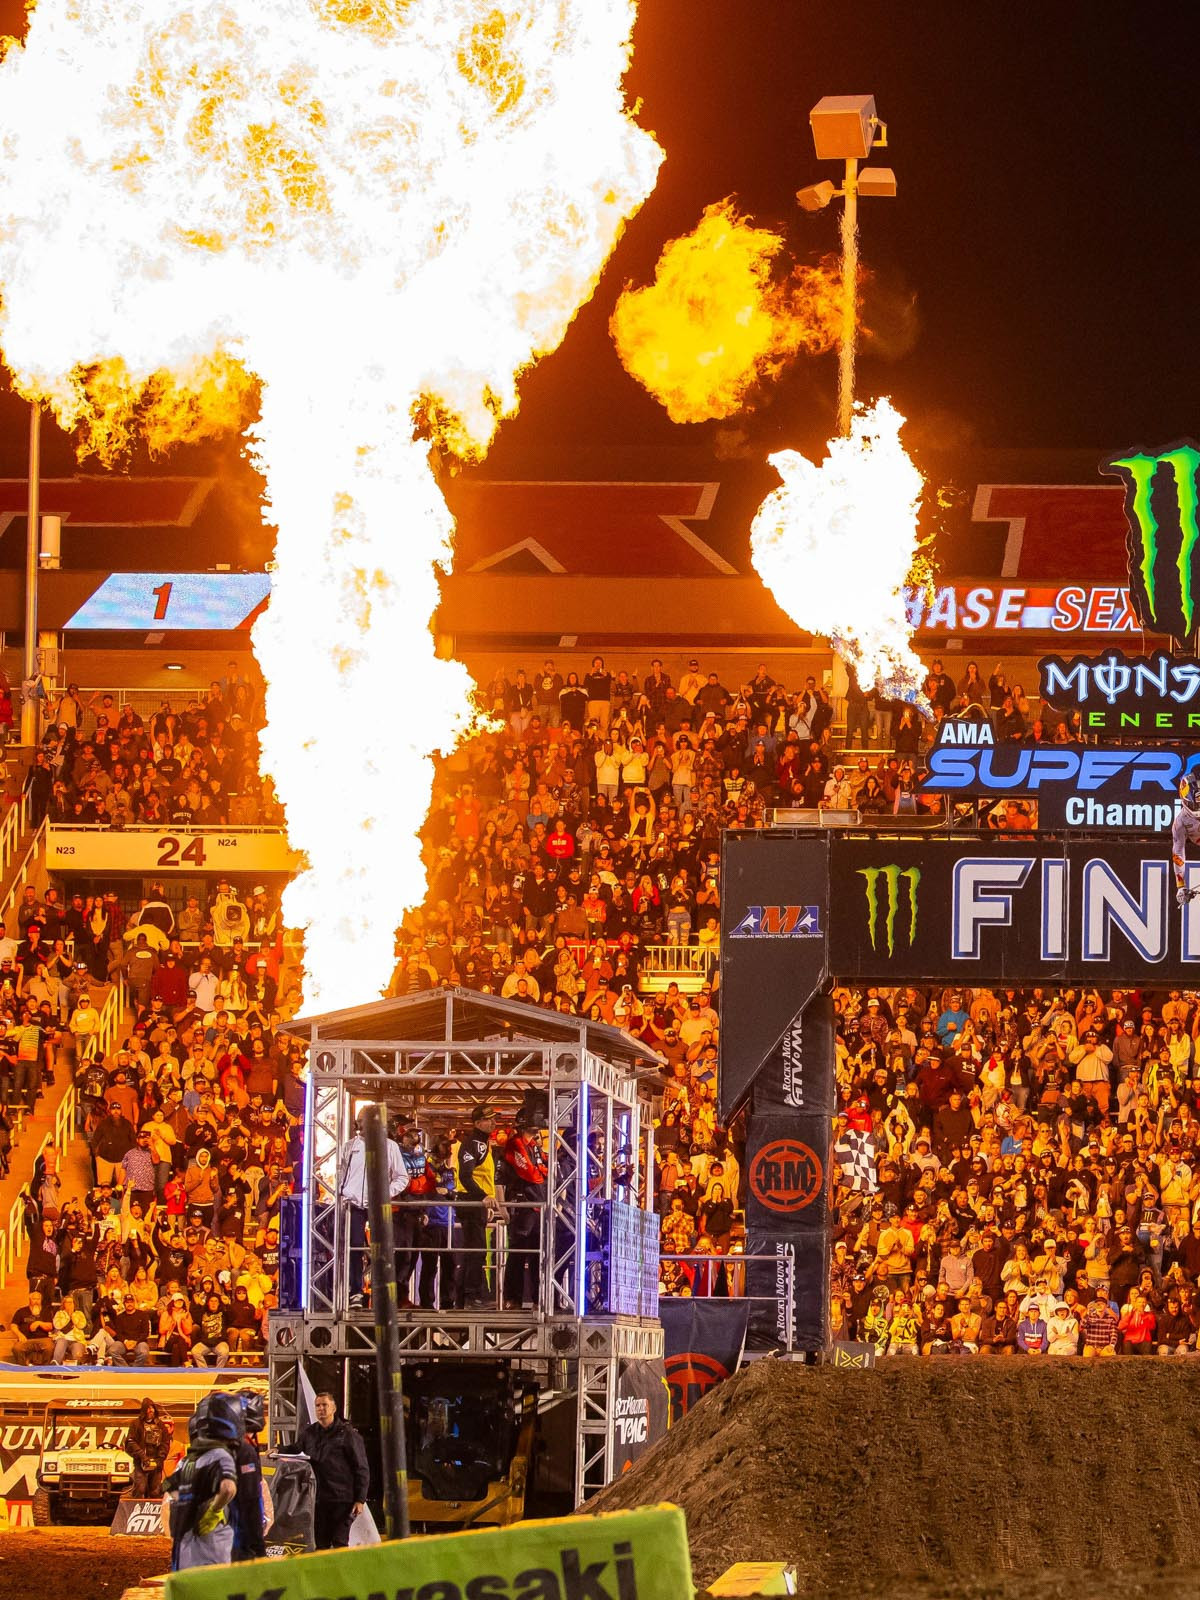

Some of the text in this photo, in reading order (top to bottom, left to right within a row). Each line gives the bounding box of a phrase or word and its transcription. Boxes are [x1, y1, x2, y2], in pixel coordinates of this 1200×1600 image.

[152, 582, 173, 620] 1
[902, 586, 1026, 629] HASE
[940, 723, 994, 746] AMA
[56, 846, 75, 855] N23
[157, 836, 207, 867] 24
[218, 838, 237, 847] N24
[729, 905, 824, 934] AMA
[763, 1160, 809, 1192] RM
